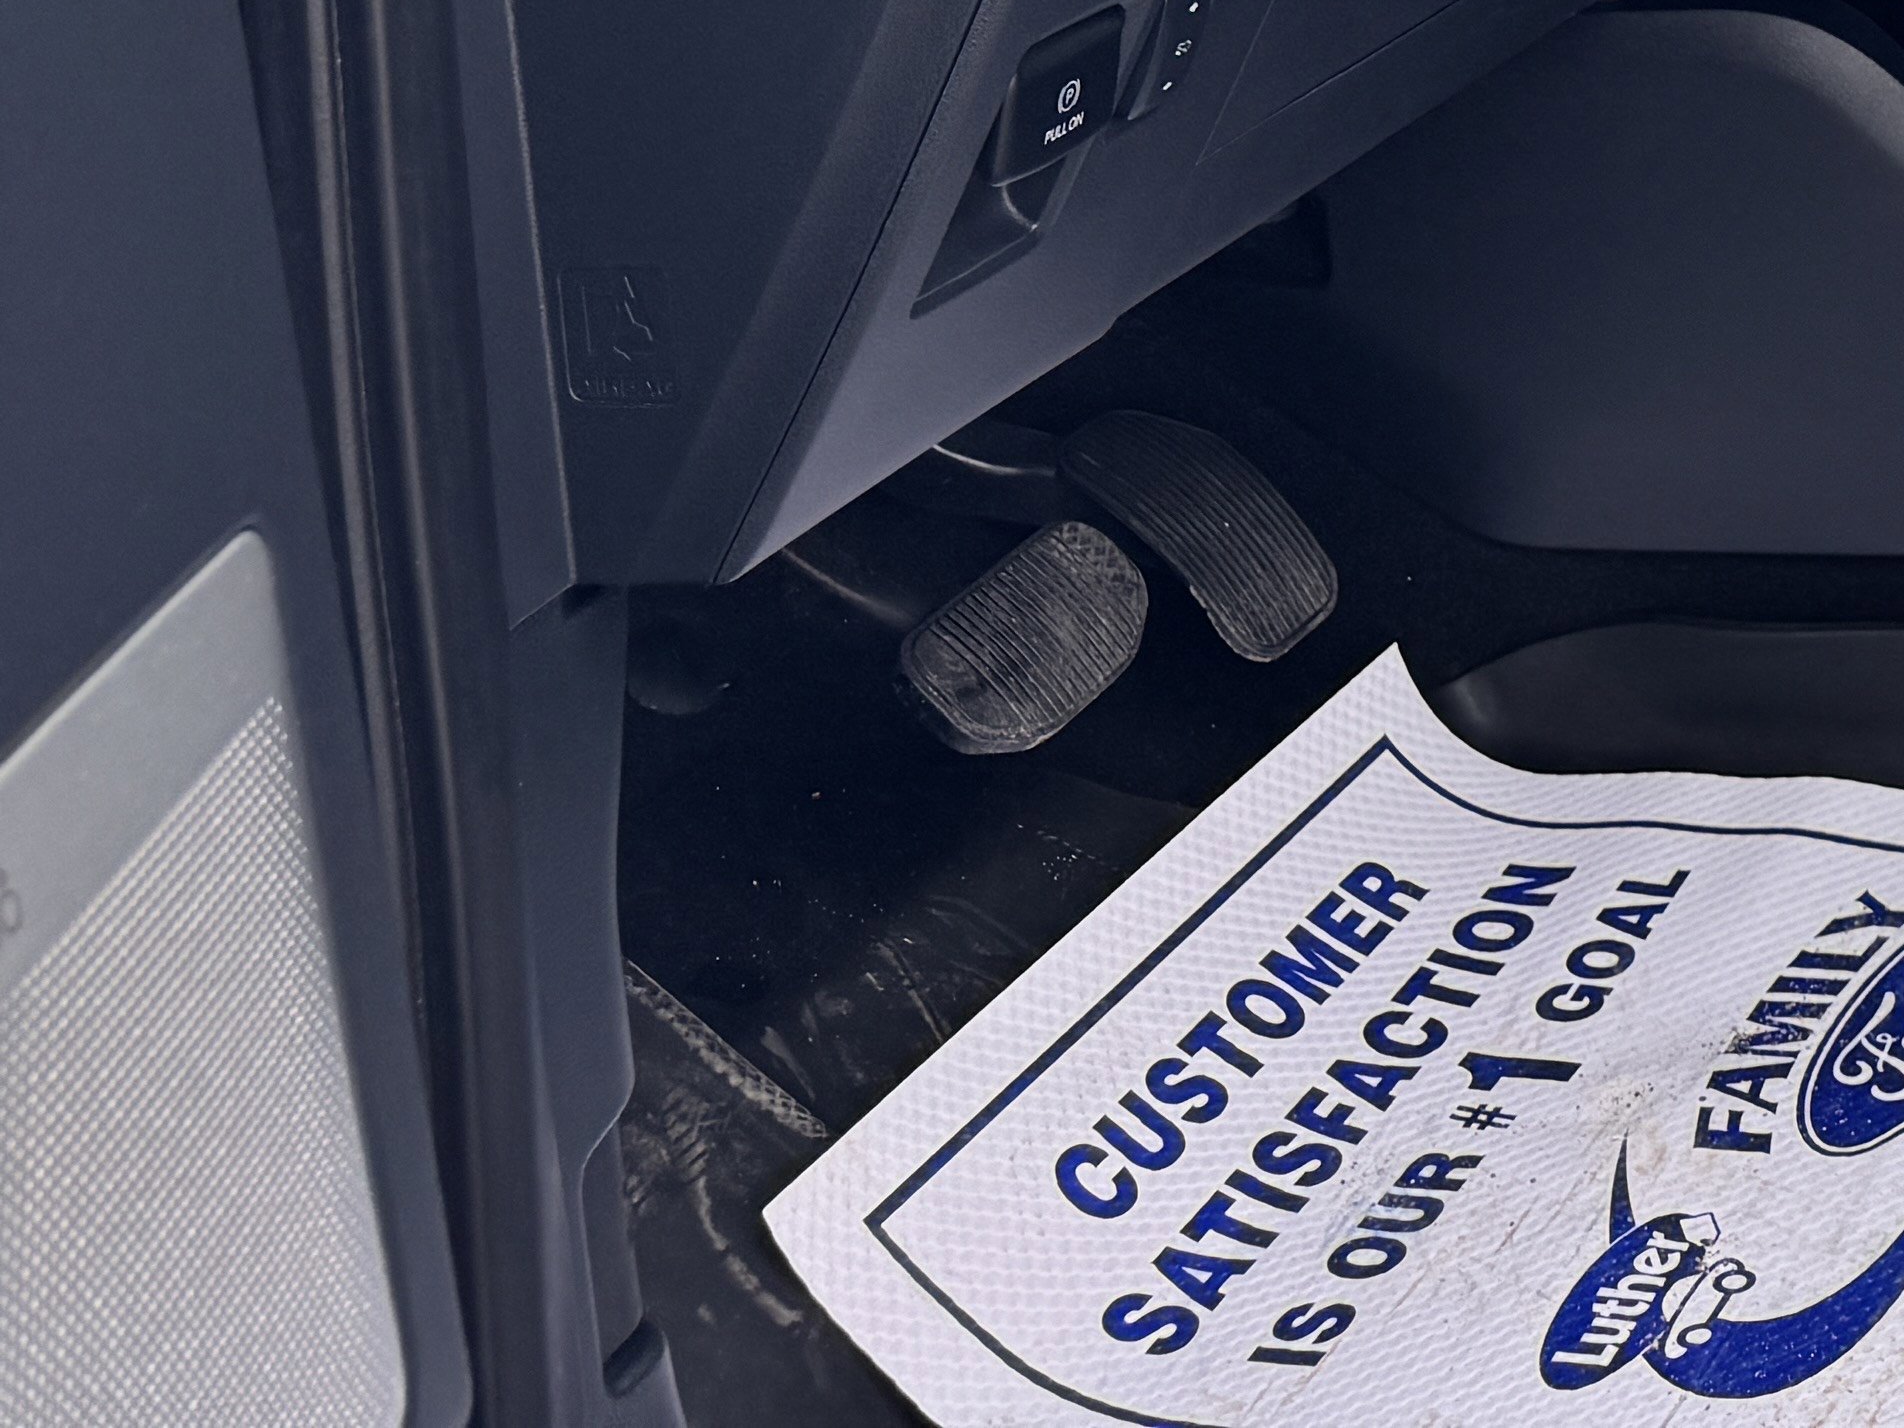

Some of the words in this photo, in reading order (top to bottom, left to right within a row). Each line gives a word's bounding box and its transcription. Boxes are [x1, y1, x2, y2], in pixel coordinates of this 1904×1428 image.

[1044, 121, 1068, 145] PULL
[1068, 110, 1085, 131] ON
[1055, 861, 1431, 1219] CUSTOMER
[1102, 863, 1577, 1355] SATISFACTION
[1247, 1301, 1357, 1367] IS
[1327, 1152, 1486, 1279] OUR
[1535, 868, 1692, 1022] GOAL
[1551, 1230, 1690, 1368] Luther
